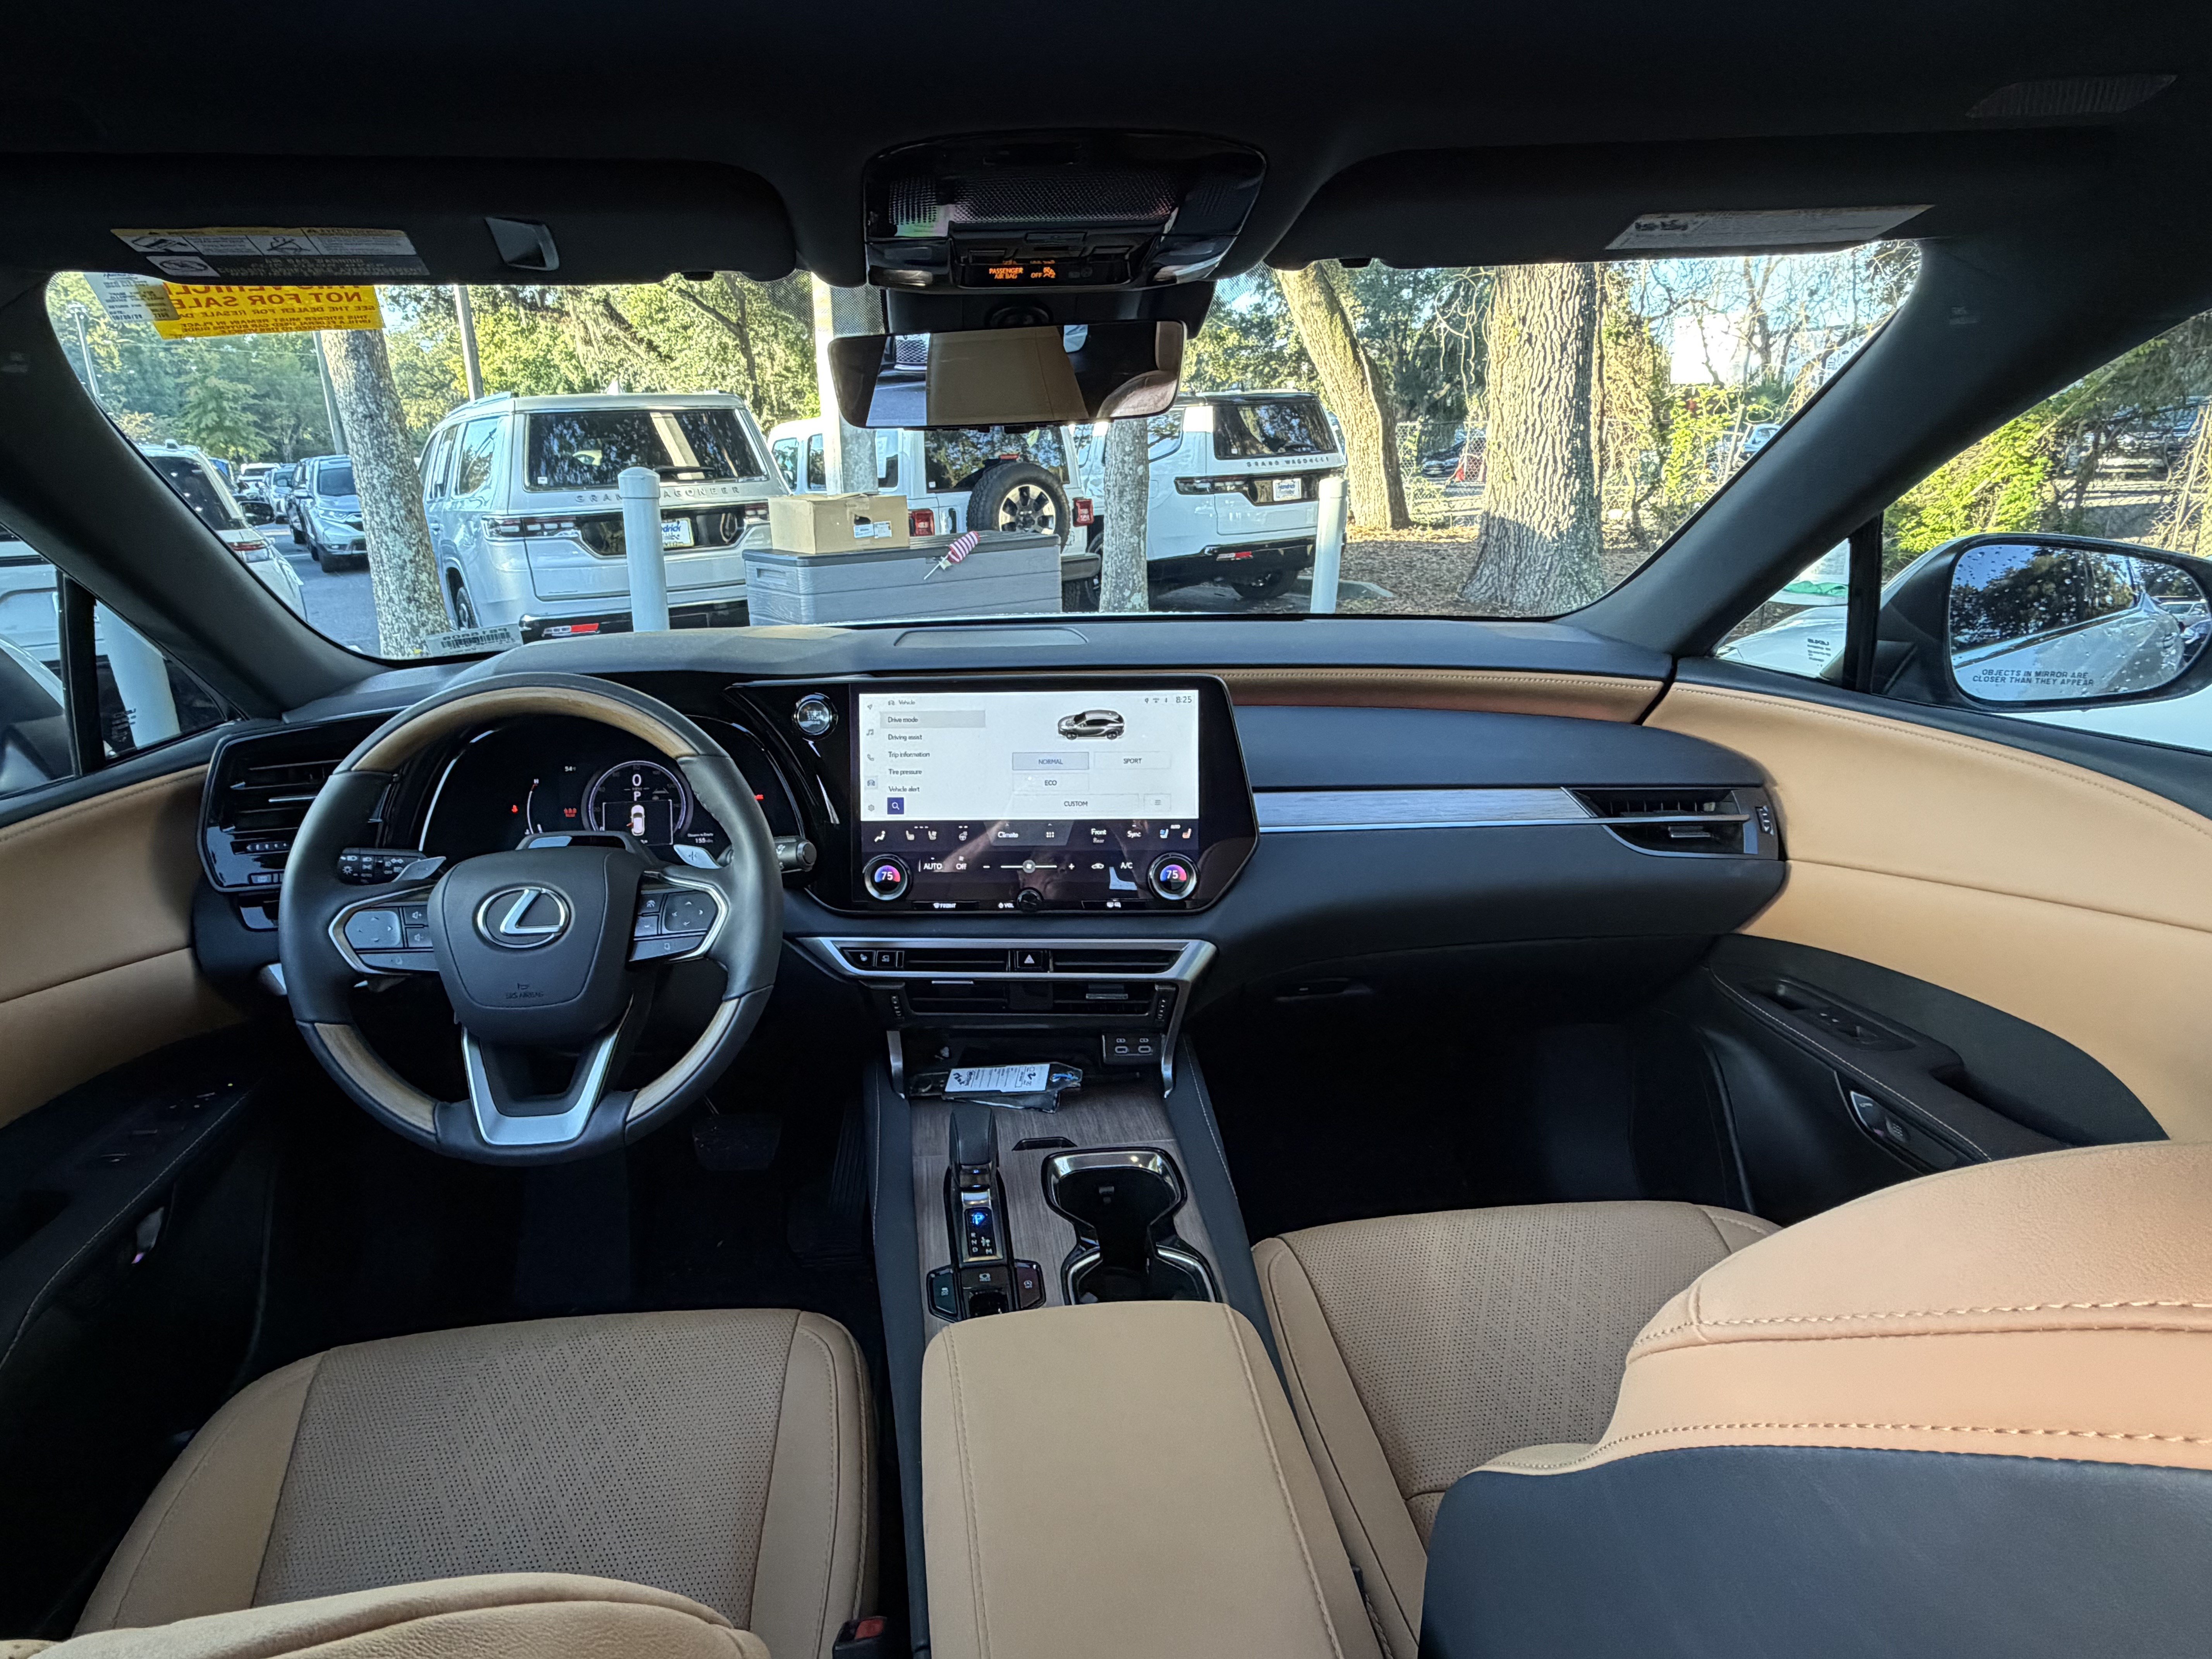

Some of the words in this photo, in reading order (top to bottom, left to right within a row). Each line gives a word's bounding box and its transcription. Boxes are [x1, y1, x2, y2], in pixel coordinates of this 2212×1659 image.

[575, 493, 622, 503] GRAN
[663, 486, 740, 498] AGONEER
[632, 774, 641, 787] 0
[634, 792, 641, 801] P
[1127, 830, 1142, 838] Sync
[881, 871, 893, 881] 75
[1166, 870, 1178, 879] 75
[973, 1213, 985, 1225] P
